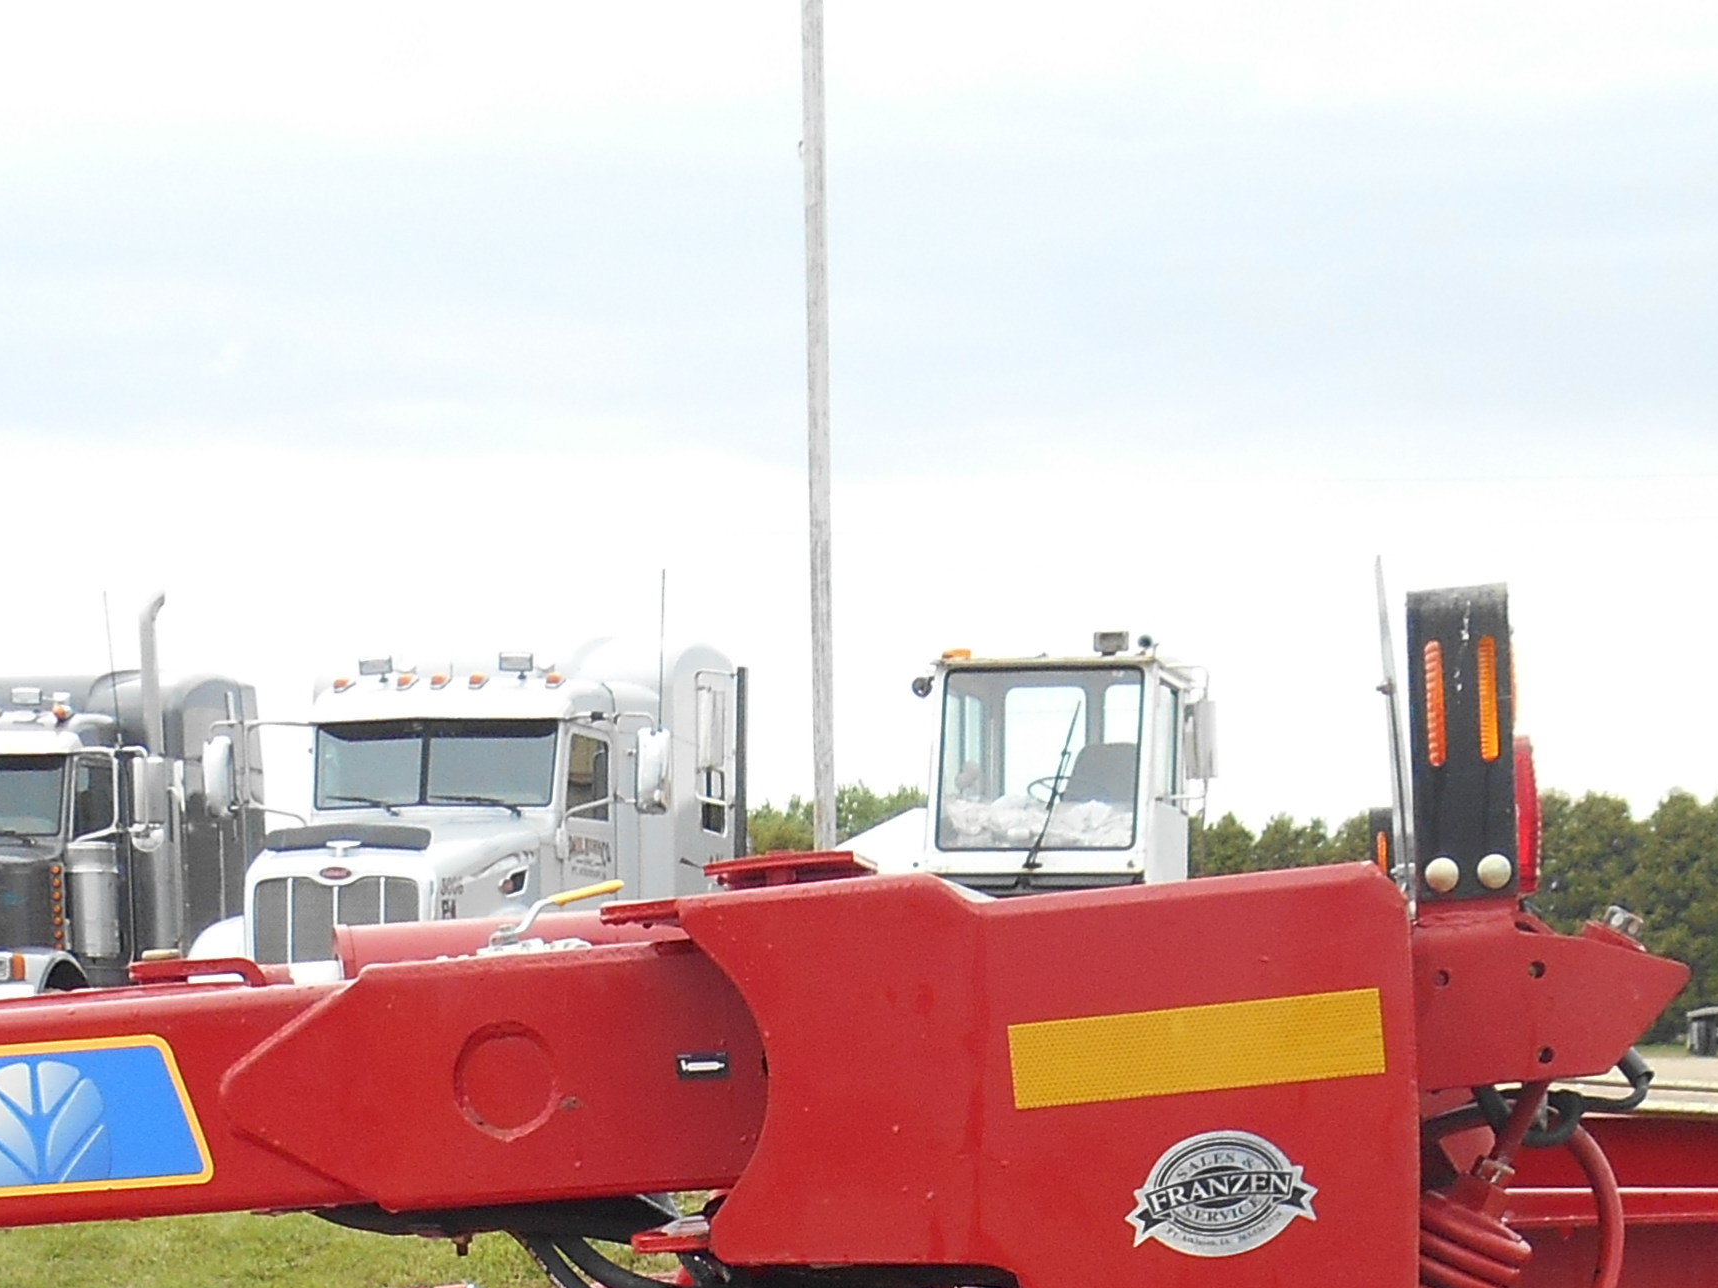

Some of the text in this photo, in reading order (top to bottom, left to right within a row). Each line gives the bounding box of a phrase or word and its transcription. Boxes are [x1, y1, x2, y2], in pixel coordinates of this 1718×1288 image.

[1175, 1153, 1255, 1179] SALES &
[1148, 1173, 1290, 1213] FRANZEN
[1184, 1196, 1260, 1222] SERVICE
